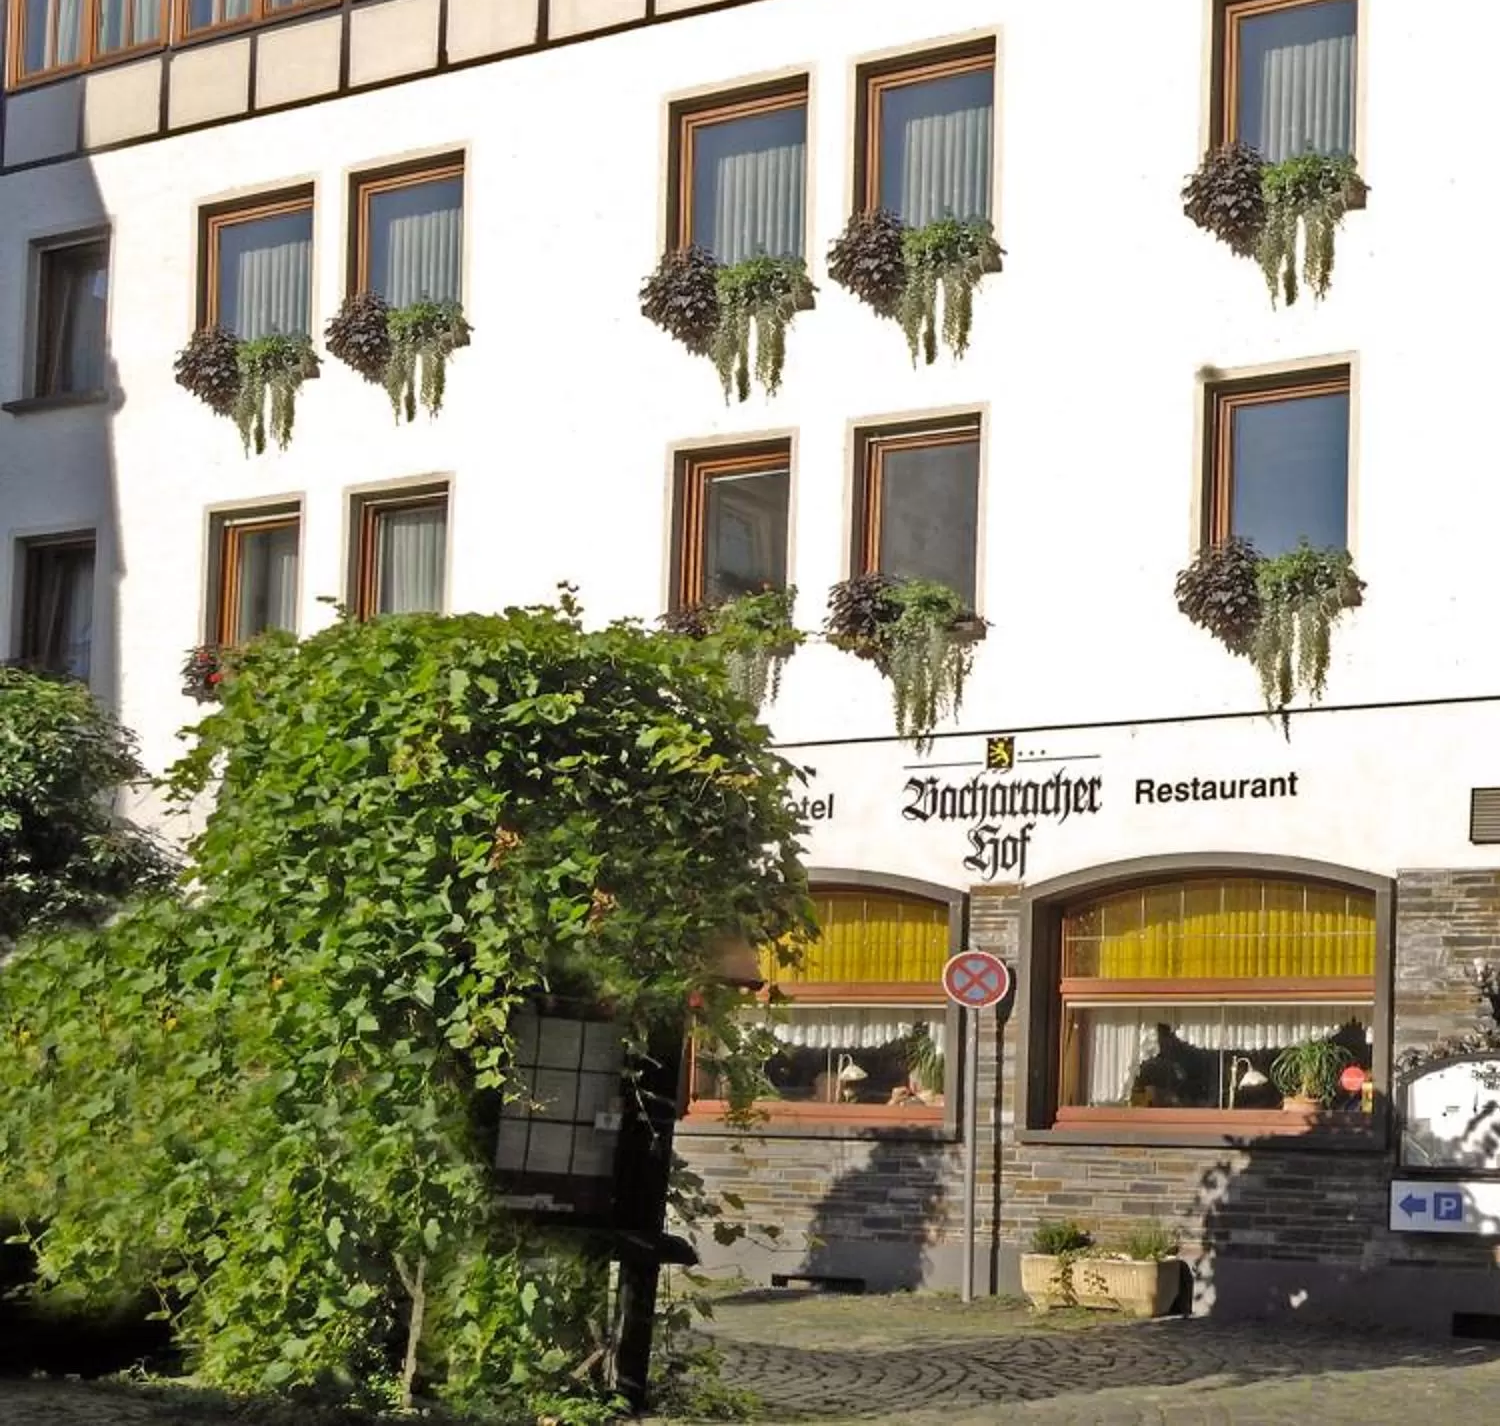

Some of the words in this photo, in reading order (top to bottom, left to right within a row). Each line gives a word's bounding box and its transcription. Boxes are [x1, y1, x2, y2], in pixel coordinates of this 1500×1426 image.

[902, 767, 1103, 824] Bacharacher
[1135, 771, 1299, 805] Restaurant
[785, 793, 834, 821] otel
[963, 822, 1034, 880] Hof
[1439, 1197, 1457, 1217] P
